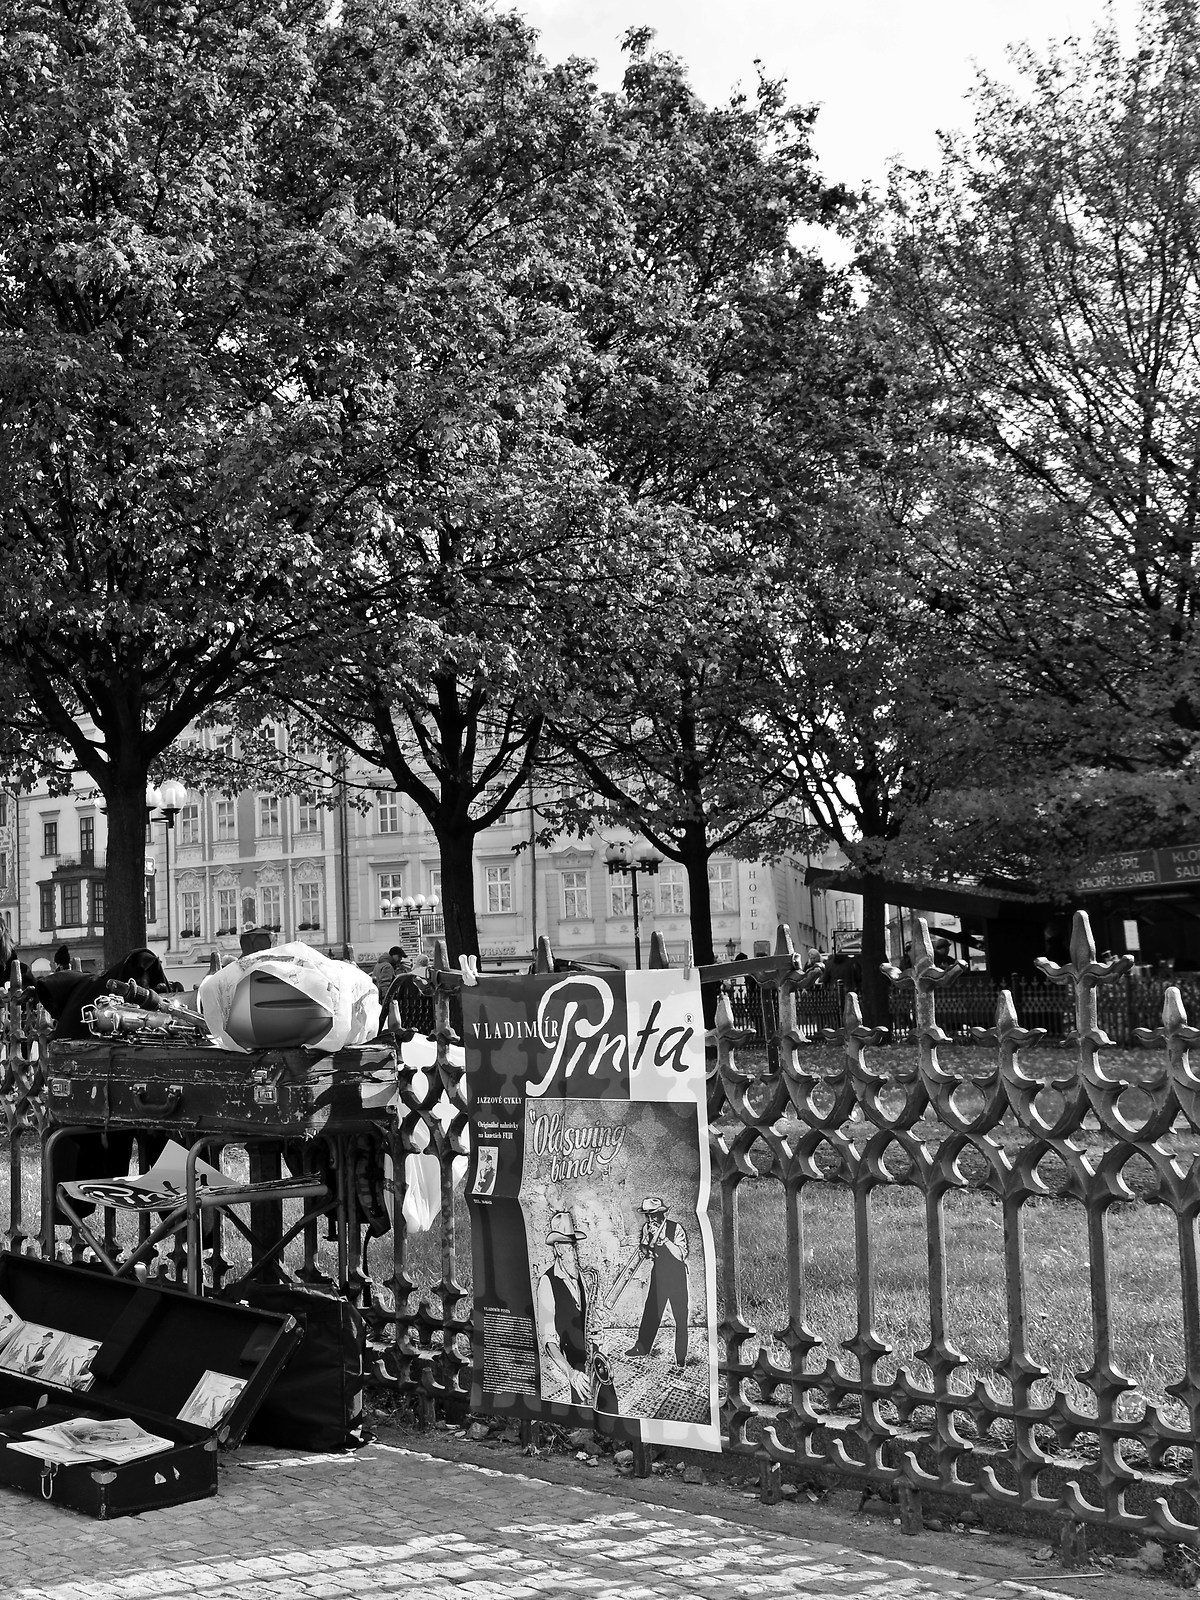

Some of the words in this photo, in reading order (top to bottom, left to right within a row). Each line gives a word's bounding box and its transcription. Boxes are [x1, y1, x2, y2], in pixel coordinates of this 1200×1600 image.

[1172, 849, 1200, 863] KLO
[748, 871, 758, 931] HOTEL
[472, 1016, 559, 1040] VLADIMÍR
[525, 975, 695, 1097] Pinta
[476, 1095, 502, 1104] JAZZOVÉ
[503, 1096, 523, 1105] CYKLY
